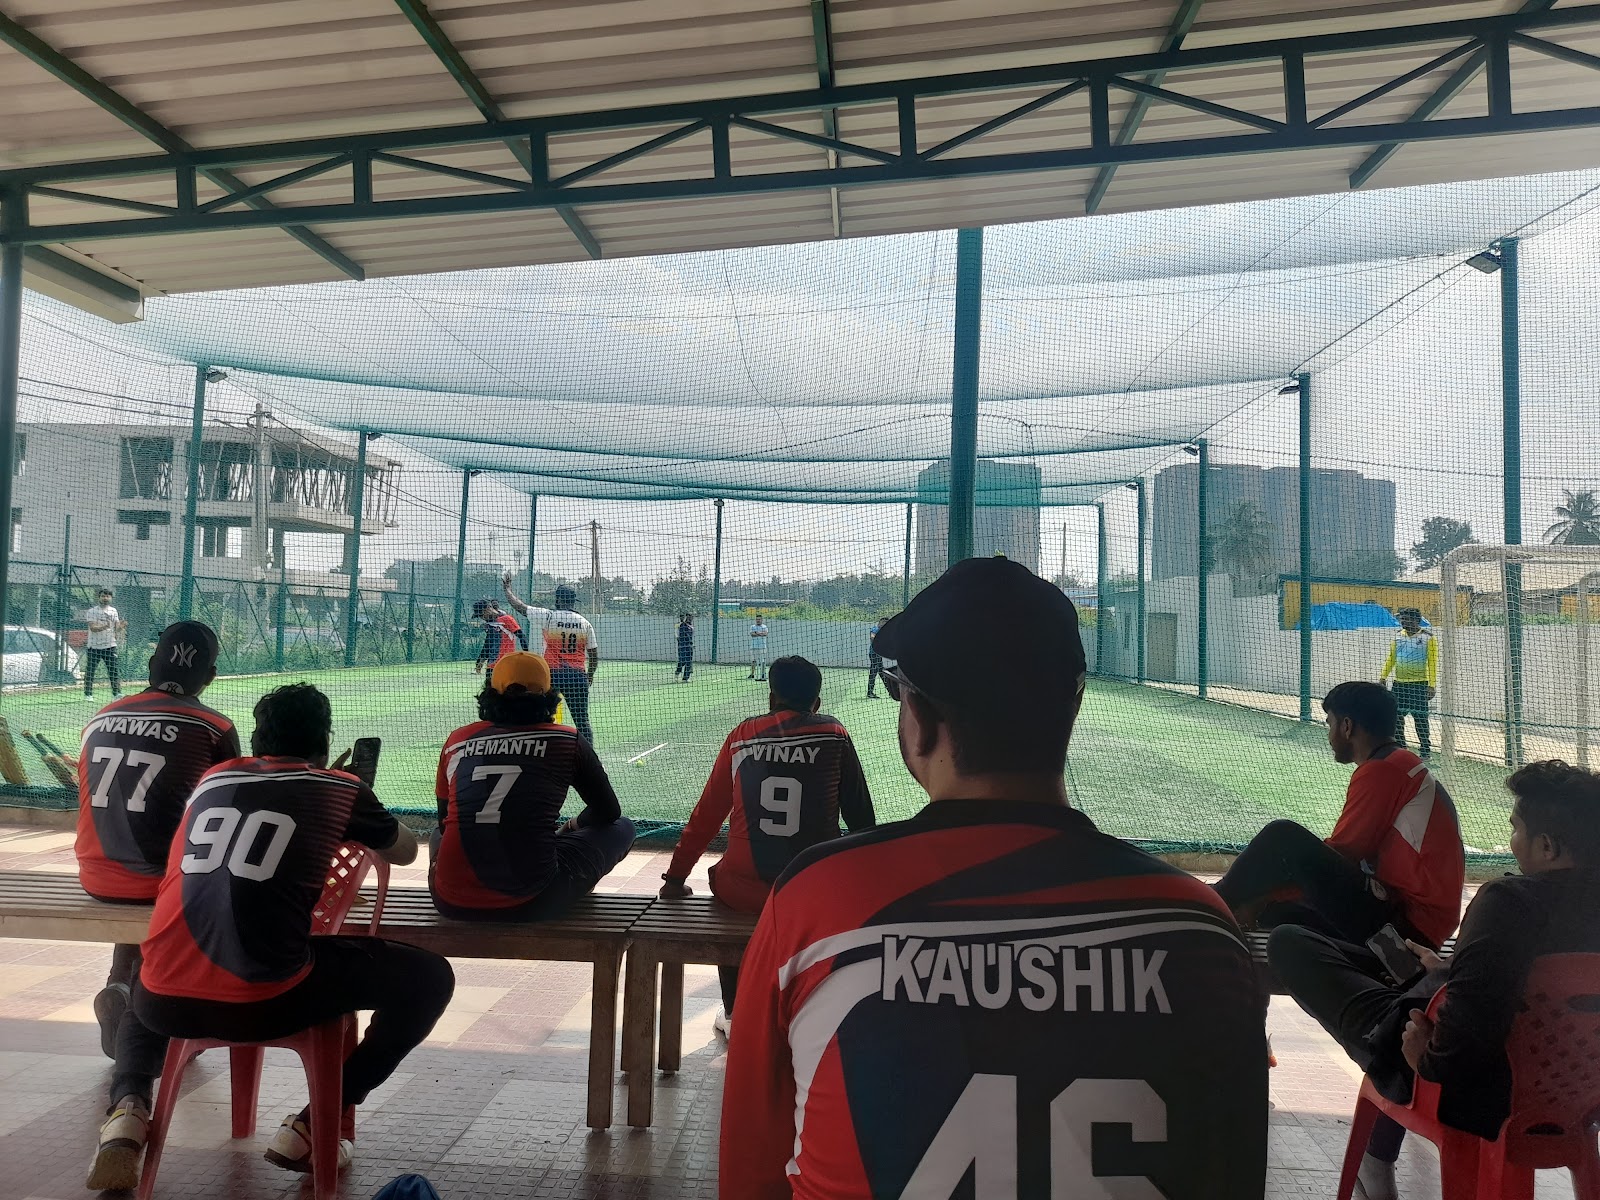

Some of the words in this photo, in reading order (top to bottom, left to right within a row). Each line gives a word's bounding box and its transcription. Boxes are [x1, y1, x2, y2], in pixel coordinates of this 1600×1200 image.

[99, 716, 179, 743] NAWAS
[464, 739, 548, 758] HEMANTH
[752, 744, 820, 764] VINAY
[91, 746, 167, 812] 77
[471, 765, 523, 824] 7
[759, 776, 802, 837] 9
[180, 806, 297, 882] 90
[881, 934, 1173, 1014] KAUSHIK
